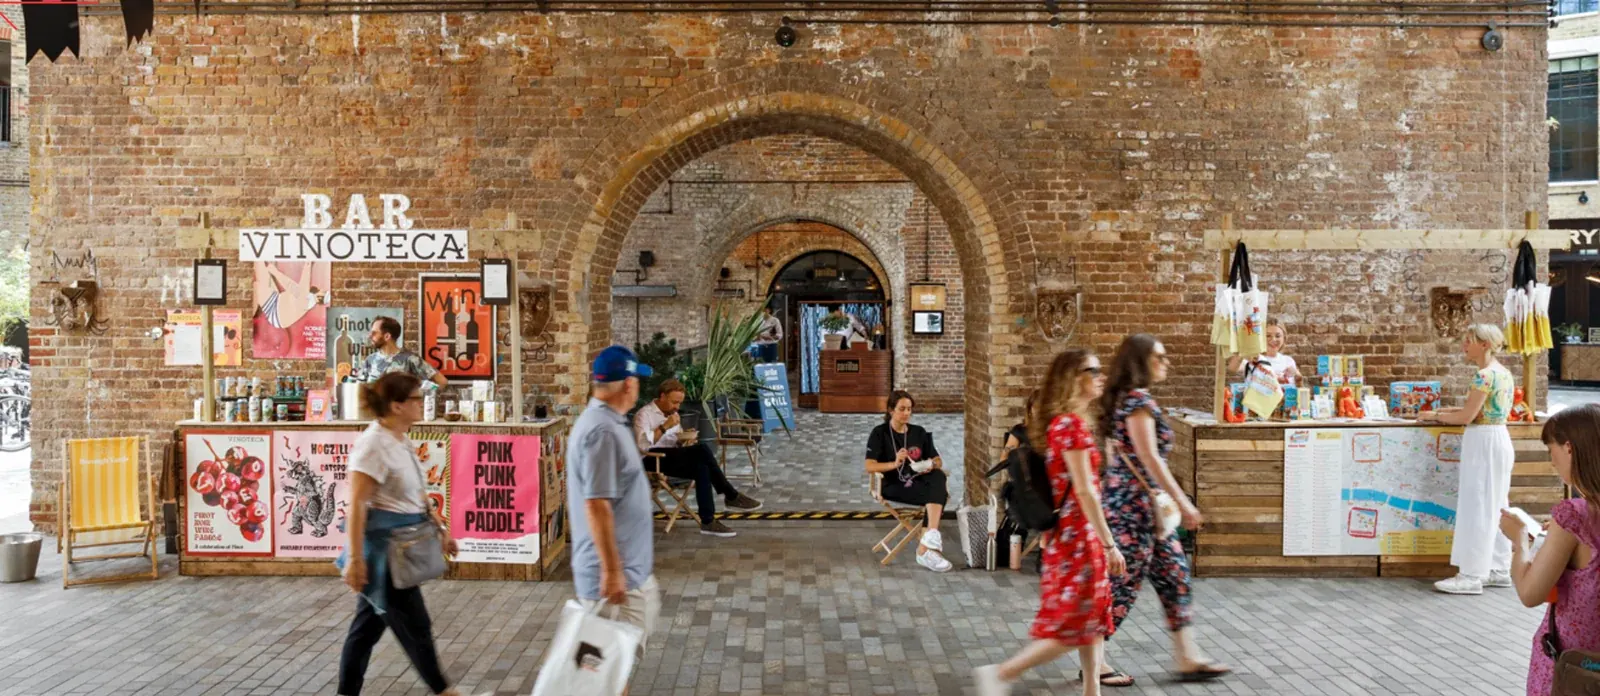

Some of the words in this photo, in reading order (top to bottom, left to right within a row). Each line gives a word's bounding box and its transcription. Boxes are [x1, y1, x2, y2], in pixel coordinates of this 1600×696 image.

[301, 193, 414, 229] BAR
[242, 231, 466, 260] VINOTECA
[477, 441, 513, 463] PINK
[474, 464, 517, 486] PUNK
[474, 487, 516, 510] WINE
[464, 510, 525, 533] PADDLE
